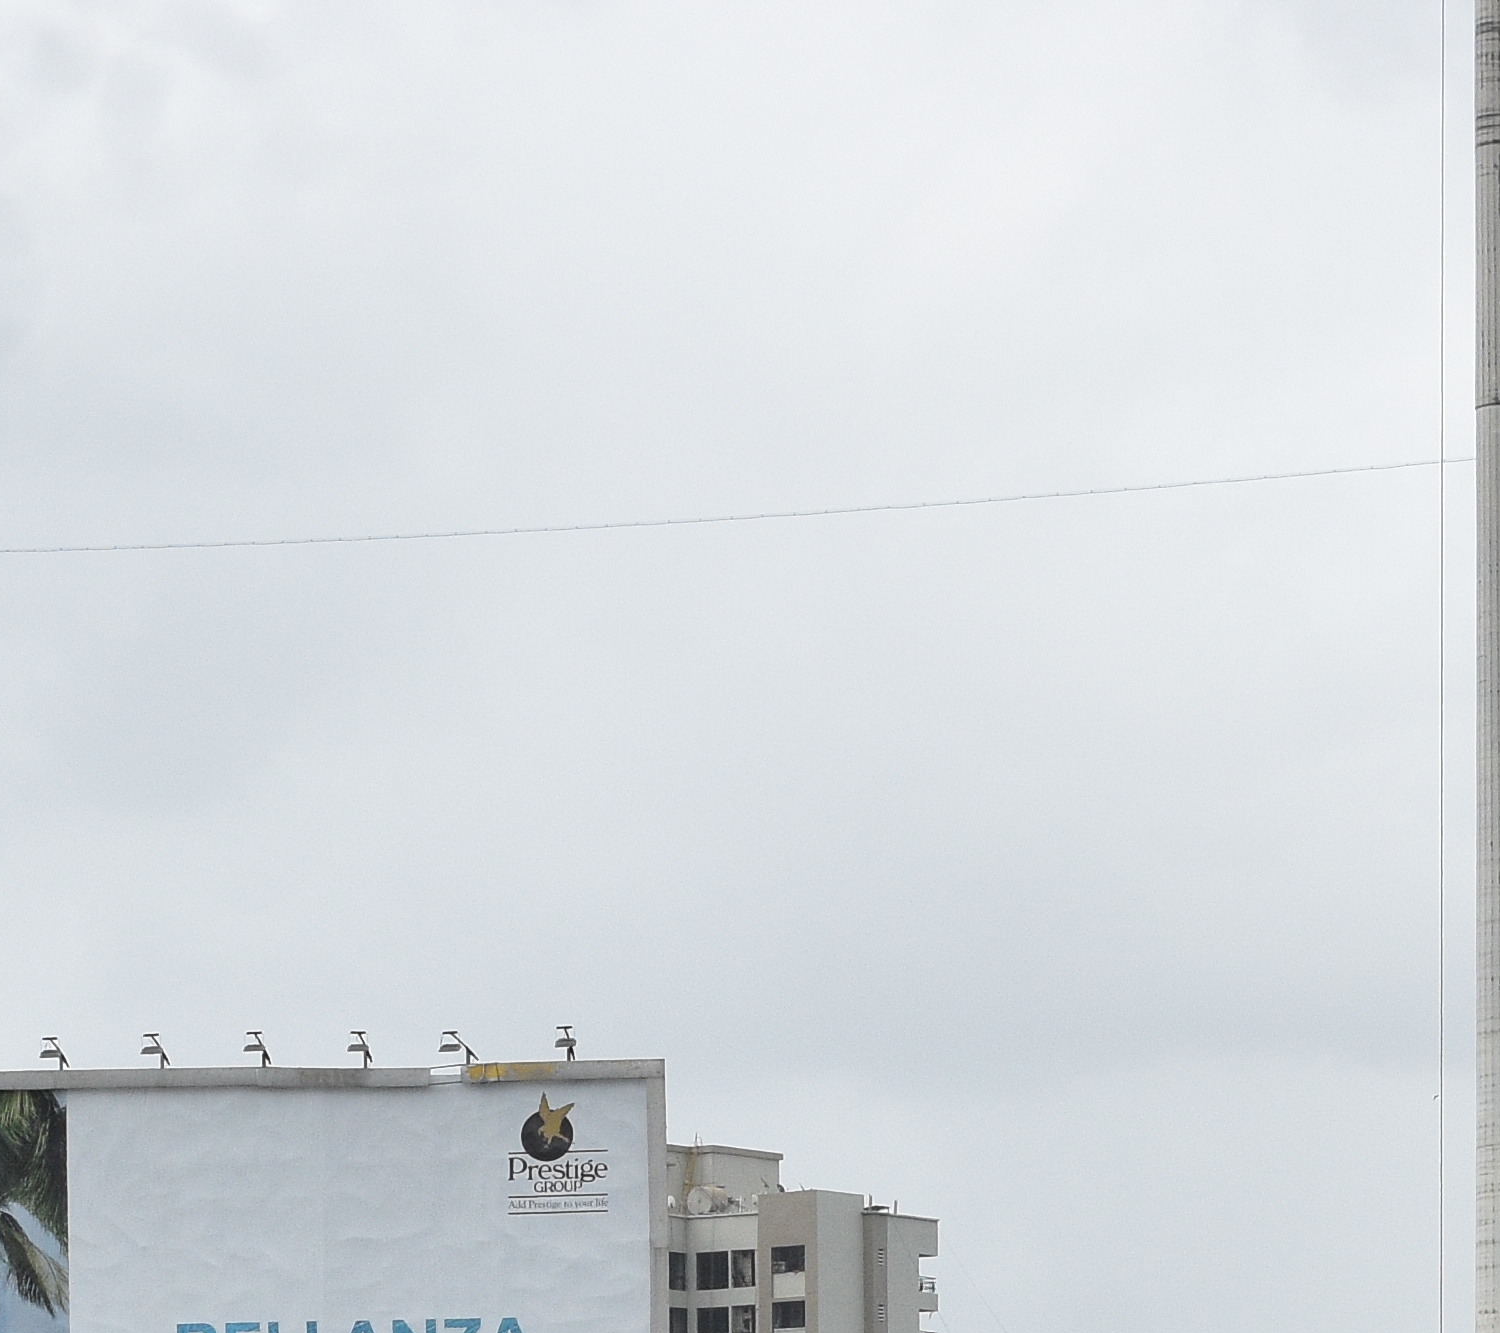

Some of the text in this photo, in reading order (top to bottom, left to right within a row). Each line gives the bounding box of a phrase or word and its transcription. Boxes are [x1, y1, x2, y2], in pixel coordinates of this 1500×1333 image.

[507, 1156, 609, 1183] Prestige
[533, 1180, 583, 1194] GROUP
[508, 1200, 527, 1209] Add
[529, 1200, 561, 1210] Prestige
